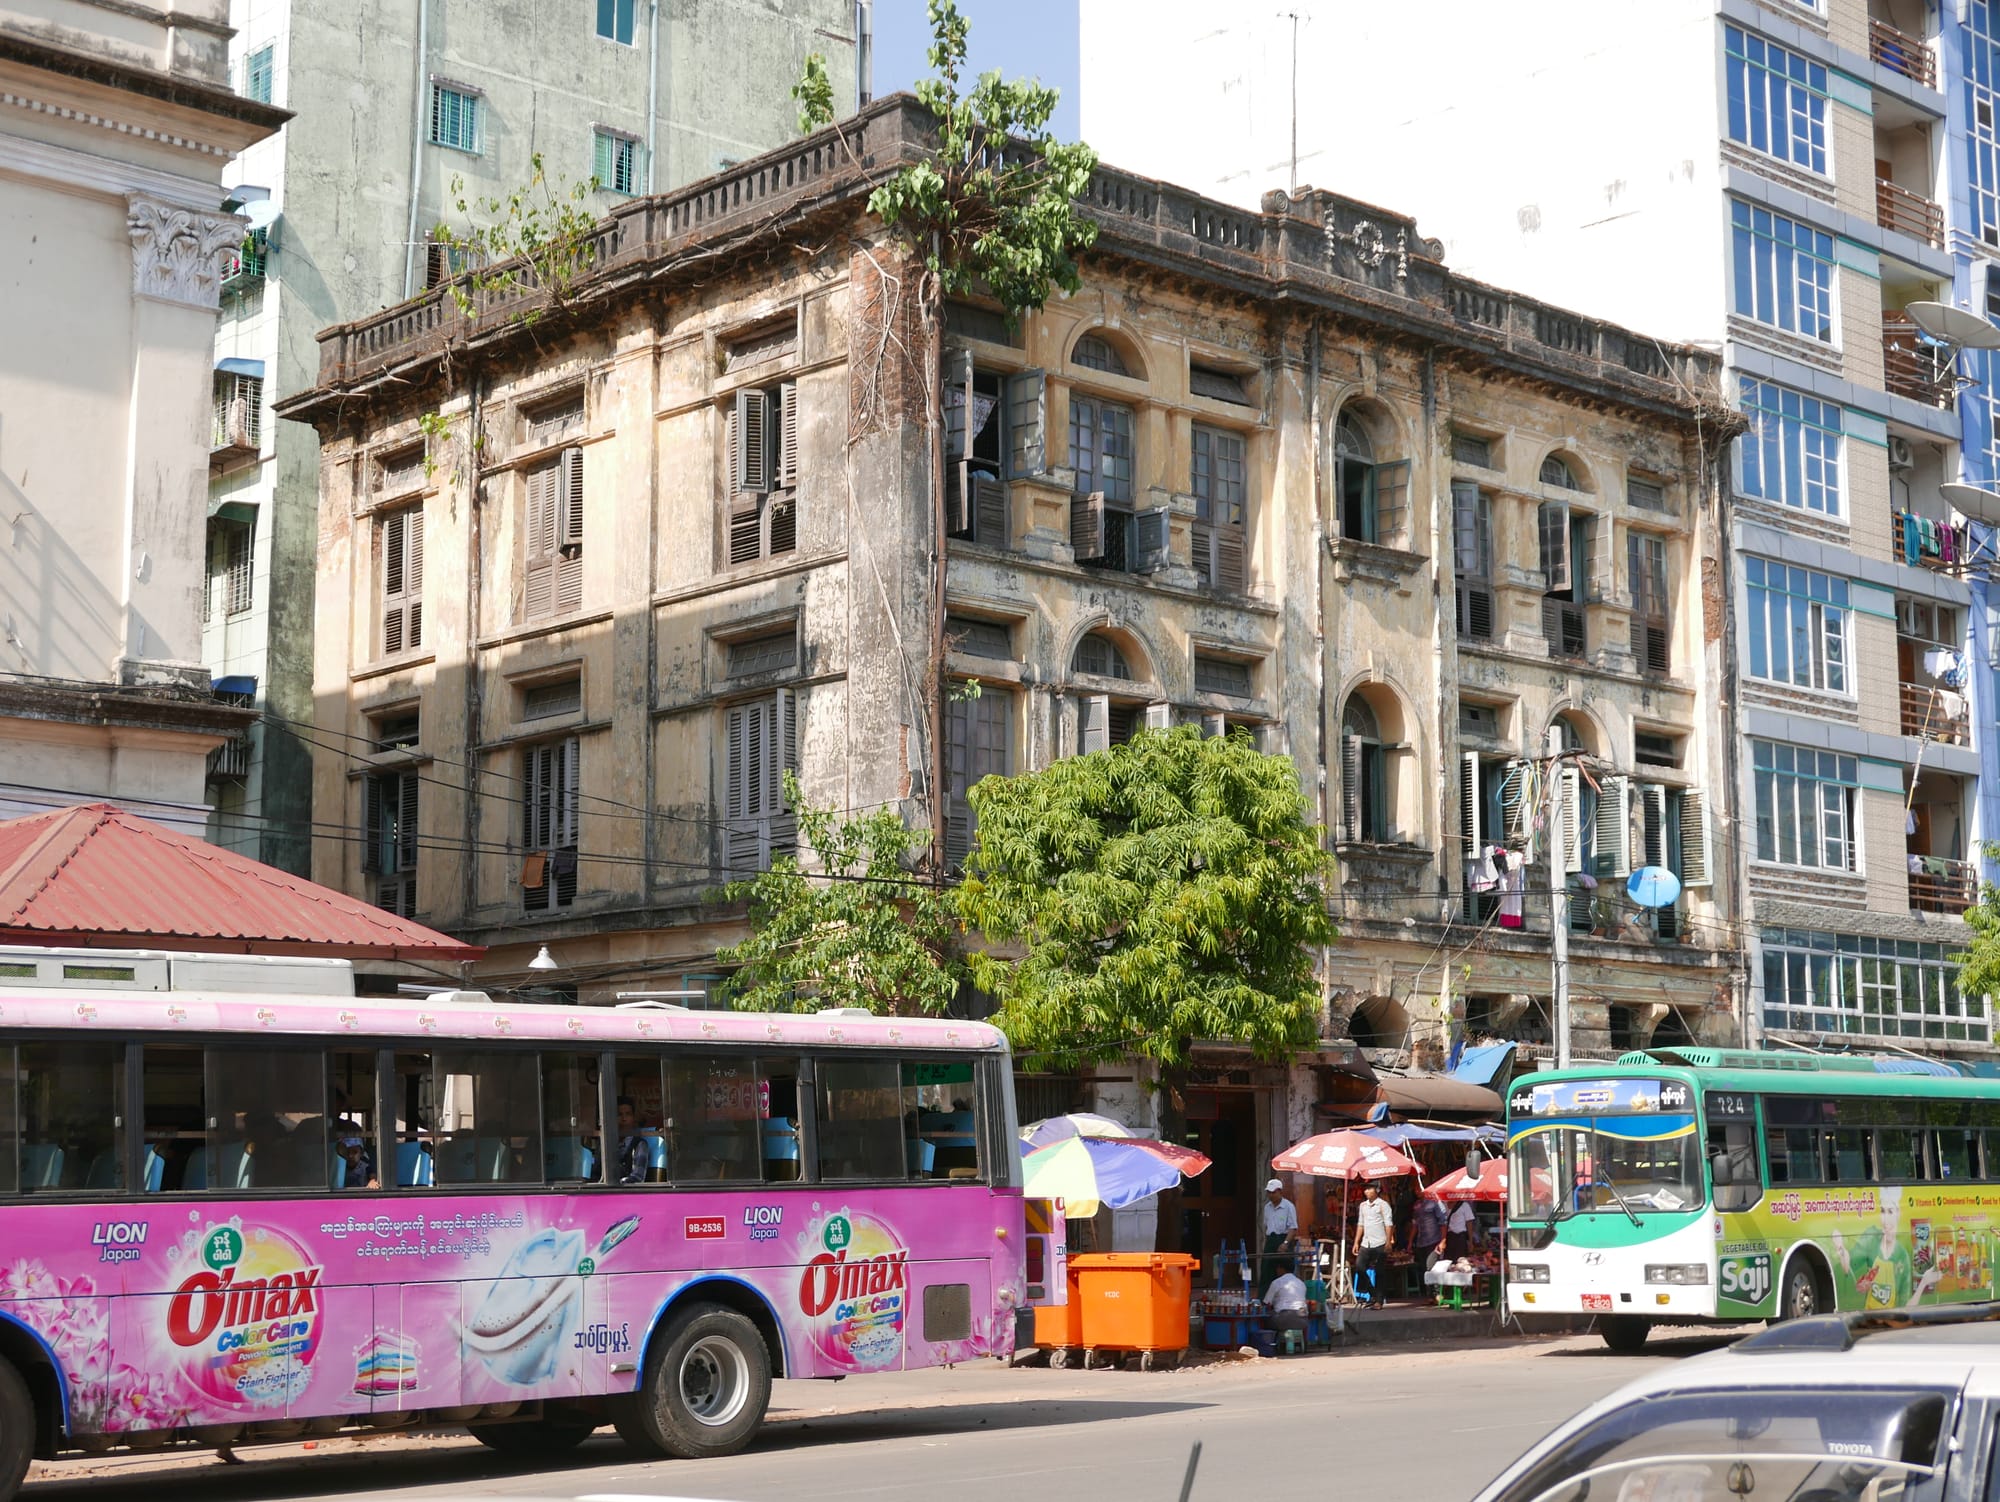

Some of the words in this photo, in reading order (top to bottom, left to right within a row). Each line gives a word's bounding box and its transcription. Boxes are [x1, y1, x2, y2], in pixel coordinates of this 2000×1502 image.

[1660, 1087, 1686, 1105] ရန်ကုန်
[1717, 1096, 1744, 1114] 724
[744, 1206, 783, 1225] LION
[92, 1222, 148, 1244] LION
[688, 1222, 722, 1233] 9B-2536
[750, 1226, 778, 1241] Japan
[100, 1246, 140, 1264] Japan
[1722, 1243, 1757, 1253] VEGETABLE
[1759, 1242, 1768, 1250] OIL
[799, 1249, 907, 1317] O'max
[1721, 1256, 1769, 1302] Saji
[167, 1267, 320, 1347] O'max
[238, 1349, 265, 1362] Powder
[266, 1342, 303, 1357] Detergent
[849, 1341, 869, 1353] Stain
[870, 1336, 895, 1350] Fighter
[236, 1375, 264, 1390] Stain
[265, 1370, 301, 1386] Fighter
[1828, 1442, 1873, 1455] TOYOTA
